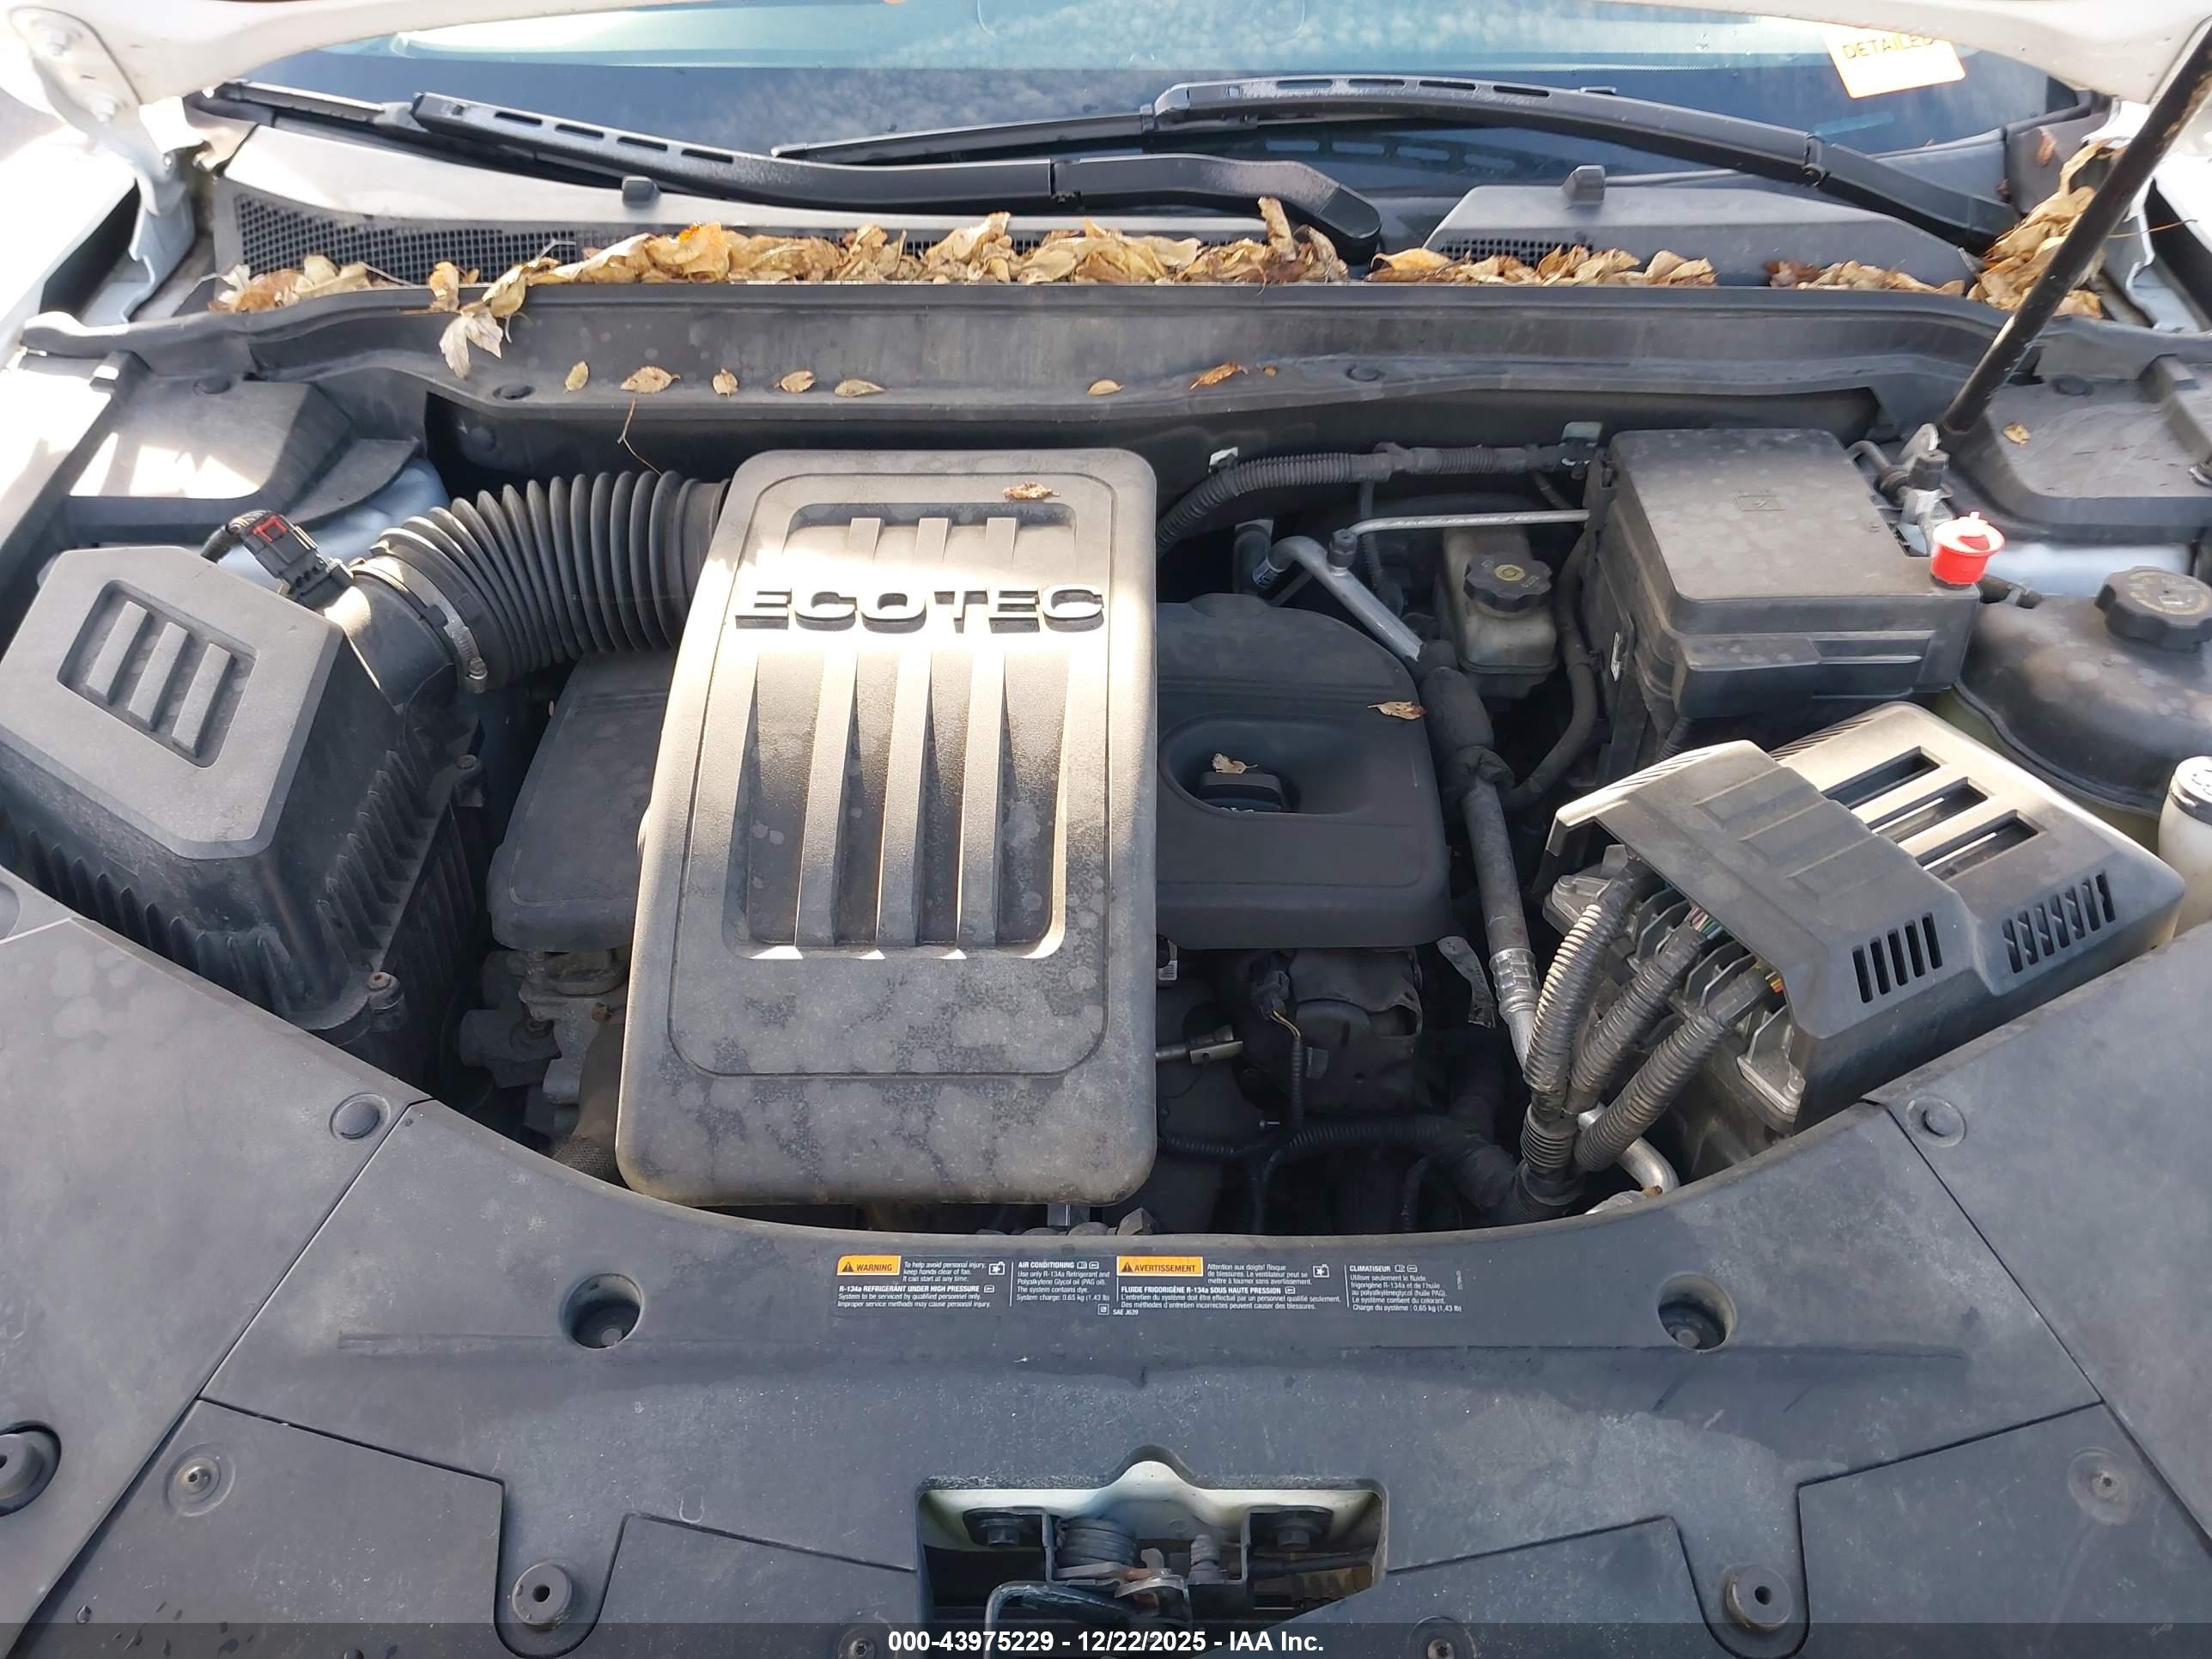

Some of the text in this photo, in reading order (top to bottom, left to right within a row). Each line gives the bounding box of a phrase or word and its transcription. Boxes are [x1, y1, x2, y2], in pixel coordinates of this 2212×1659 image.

[734, 584, 1104, 634] ECOTEC
[912, 1261, 925, 1270] help
[942, 1261, 968, 1270] personal
[1134, 1264, 1196, 1273] AVERTISSEMENT
[1245, 1263, 1266, 1272] doigts!
[1286, 1271, 1300, 1279] peut
[1351, 1281, 1382, 1290] frigorigène
[1161, 1294, 1186, 1303] système
[1256, 1295, 1285, 1304] personnel
[1286, 1295, 1308, 1304] qualifié
[946, 1300, 973, 1309] personal
[973, 1300, 991, 1309] injury.
[1229, 1302, 1253, 1310] peuvent
[1352, 1304, 1374, 1313] Charge
[1383, 1304, 1409, 1313] système
[1413, 1304, 1427, 1313] 0,65
[1427, 1304, 1437, 1313] kg
